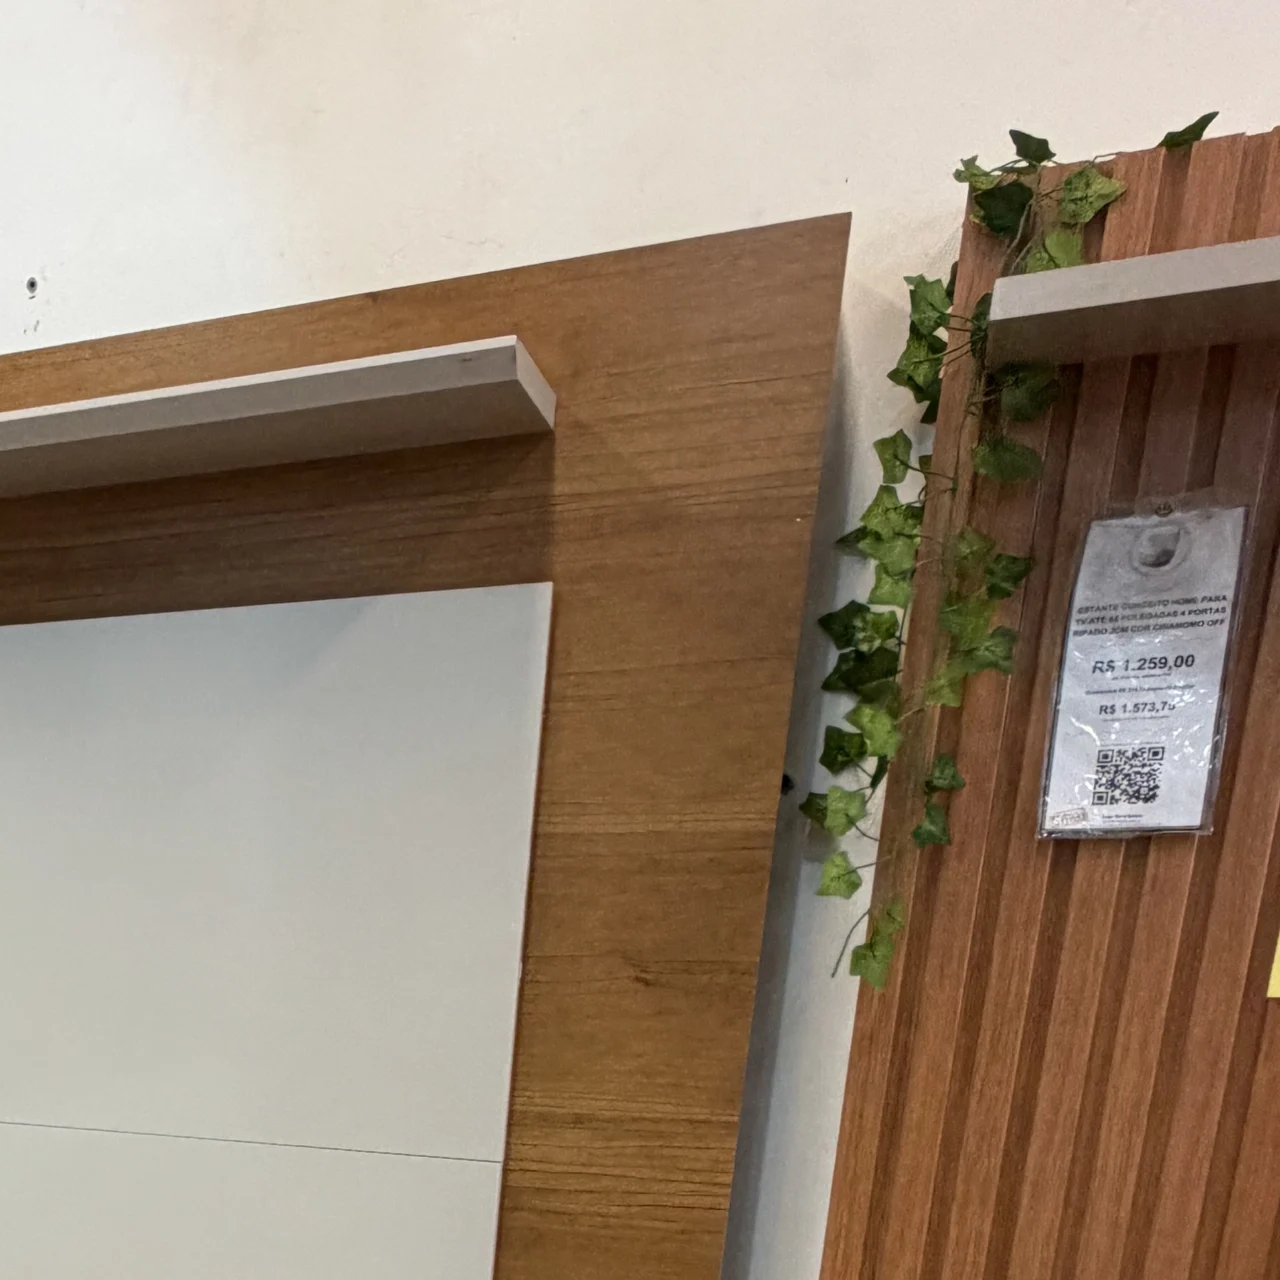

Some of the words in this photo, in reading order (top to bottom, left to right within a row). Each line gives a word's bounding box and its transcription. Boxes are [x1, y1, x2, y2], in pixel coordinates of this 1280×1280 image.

[1188, 606, 1226, 616] PORTAS
[1092, 660, 1116, 674] R$
[1124, 654, 1195, 671] 1.259,00
[1099, 704, 1117, 715] R$
